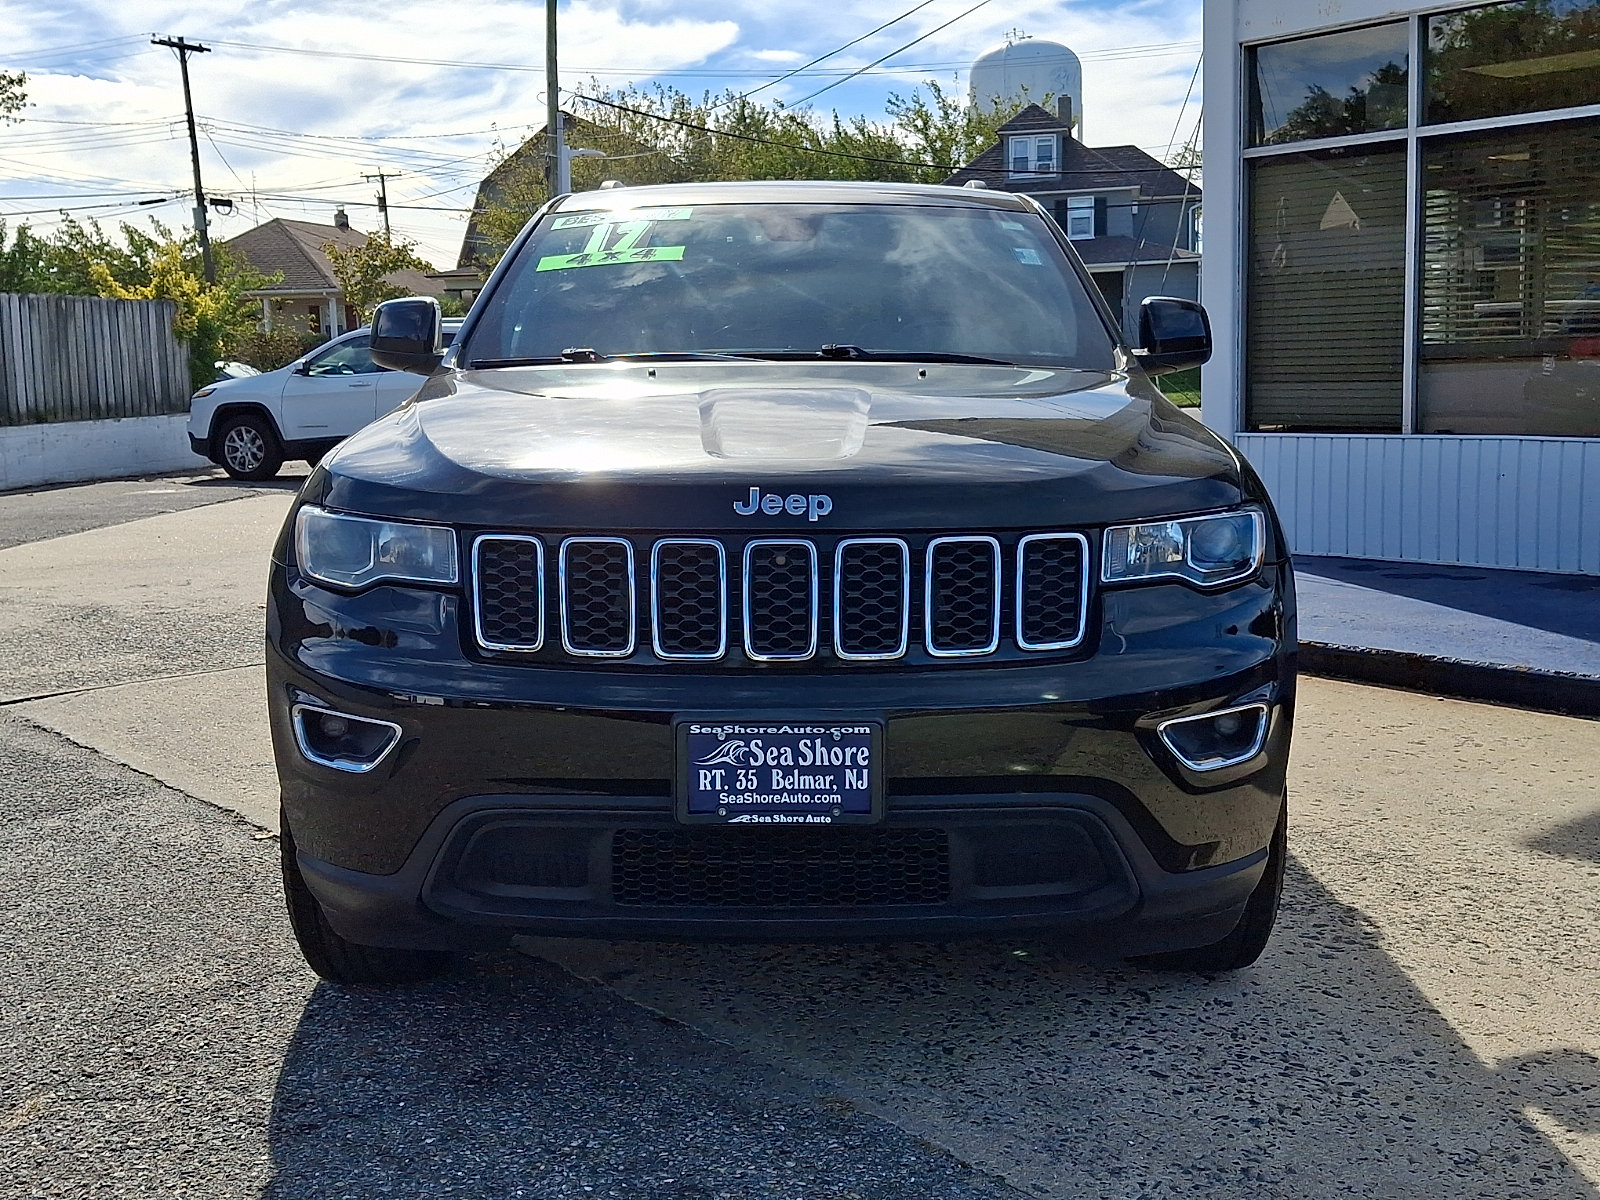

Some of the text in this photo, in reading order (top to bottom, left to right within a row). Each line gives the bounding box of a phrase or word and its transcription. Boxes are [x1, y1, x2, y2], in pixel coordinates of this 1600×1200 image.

[583, 219, 652, 253] 17
[733, 486, 833, 522] Jeep
[689, 725, 871, 735] SeaShoreAuto.com
[749, 738, 870, 767] Sea Shore
[698, 768, 869, 792] RT. 35 Belmar, NJ
[719, 792, 842, 804] SeaShoreAuto.com
[751, 814, 832, 824] Sea Shore Auto
